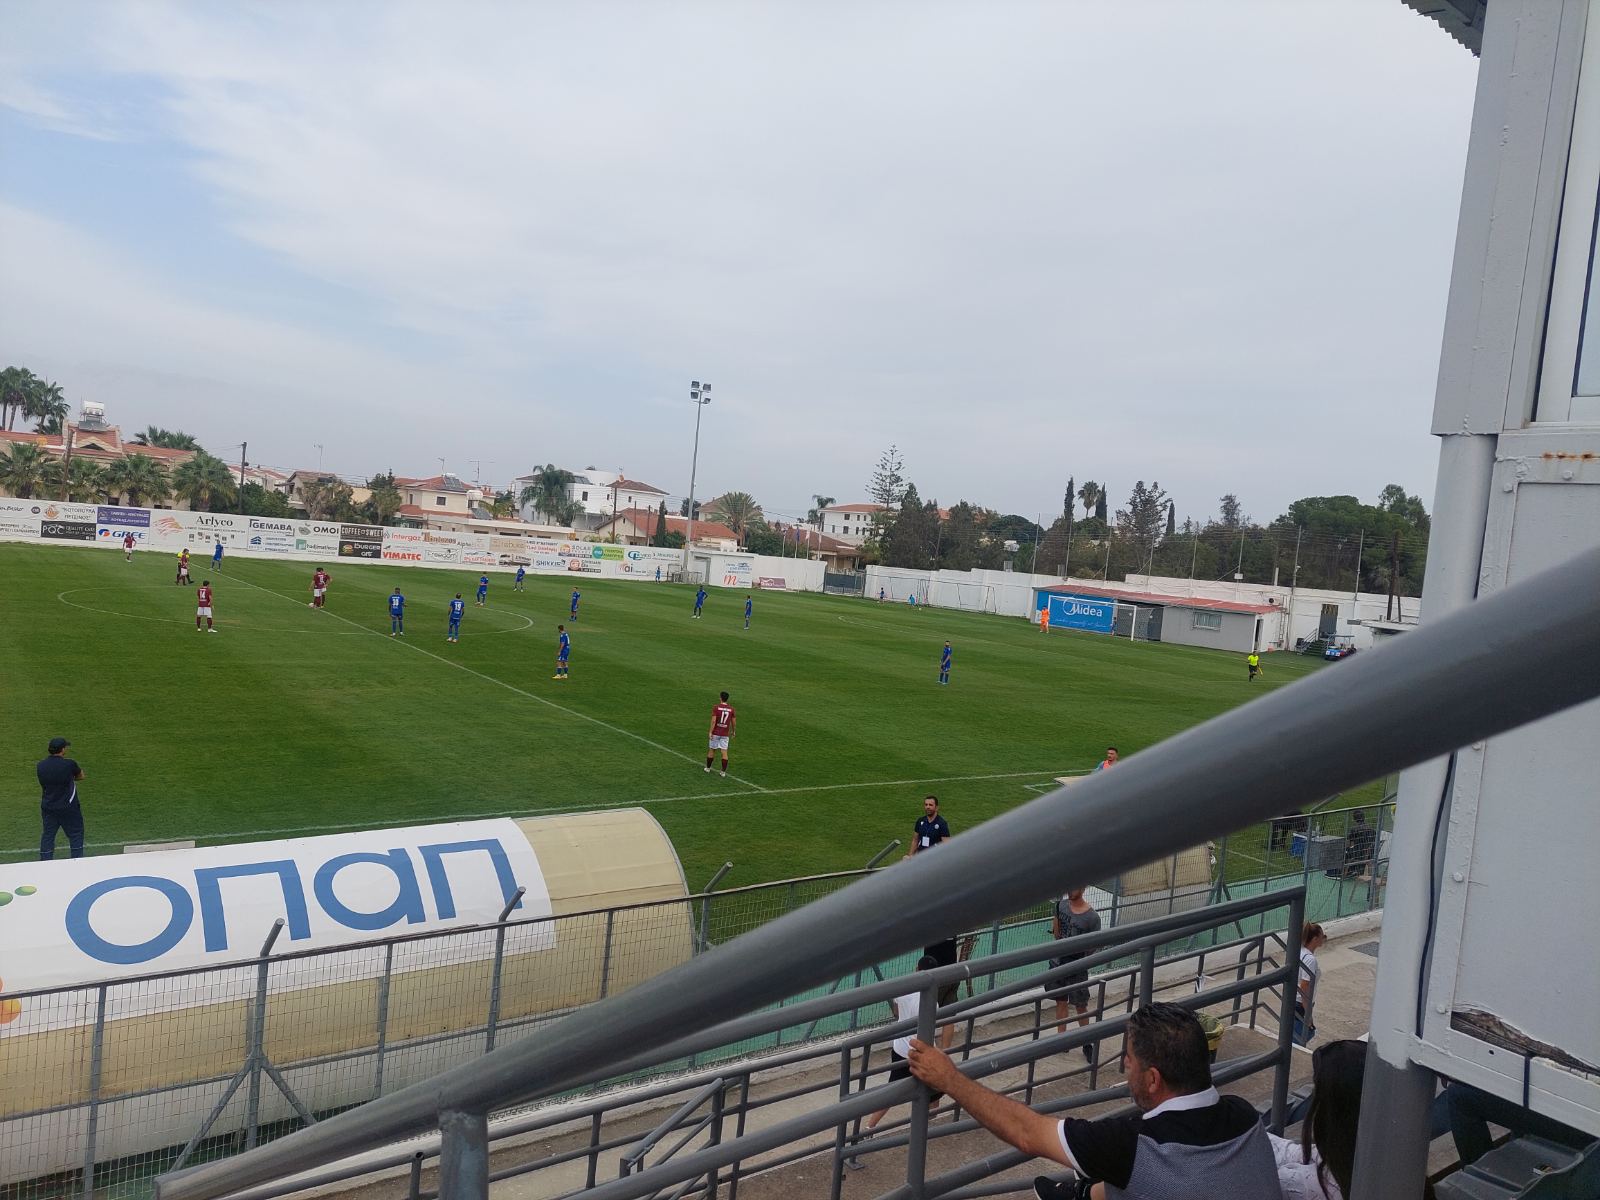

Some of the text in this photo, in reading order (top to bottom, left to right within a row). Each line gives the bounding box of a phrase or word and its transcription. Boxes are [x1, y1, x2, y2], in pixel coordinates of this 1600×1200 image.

[196, 515, 233, 528] Arlyco
[252, 522, 293, 532] GEMABA
[383, 551, 422, 561] VIMATEC
[1064, 600, 1103, 617] Midea
[720, 711, 729, 724] 17
